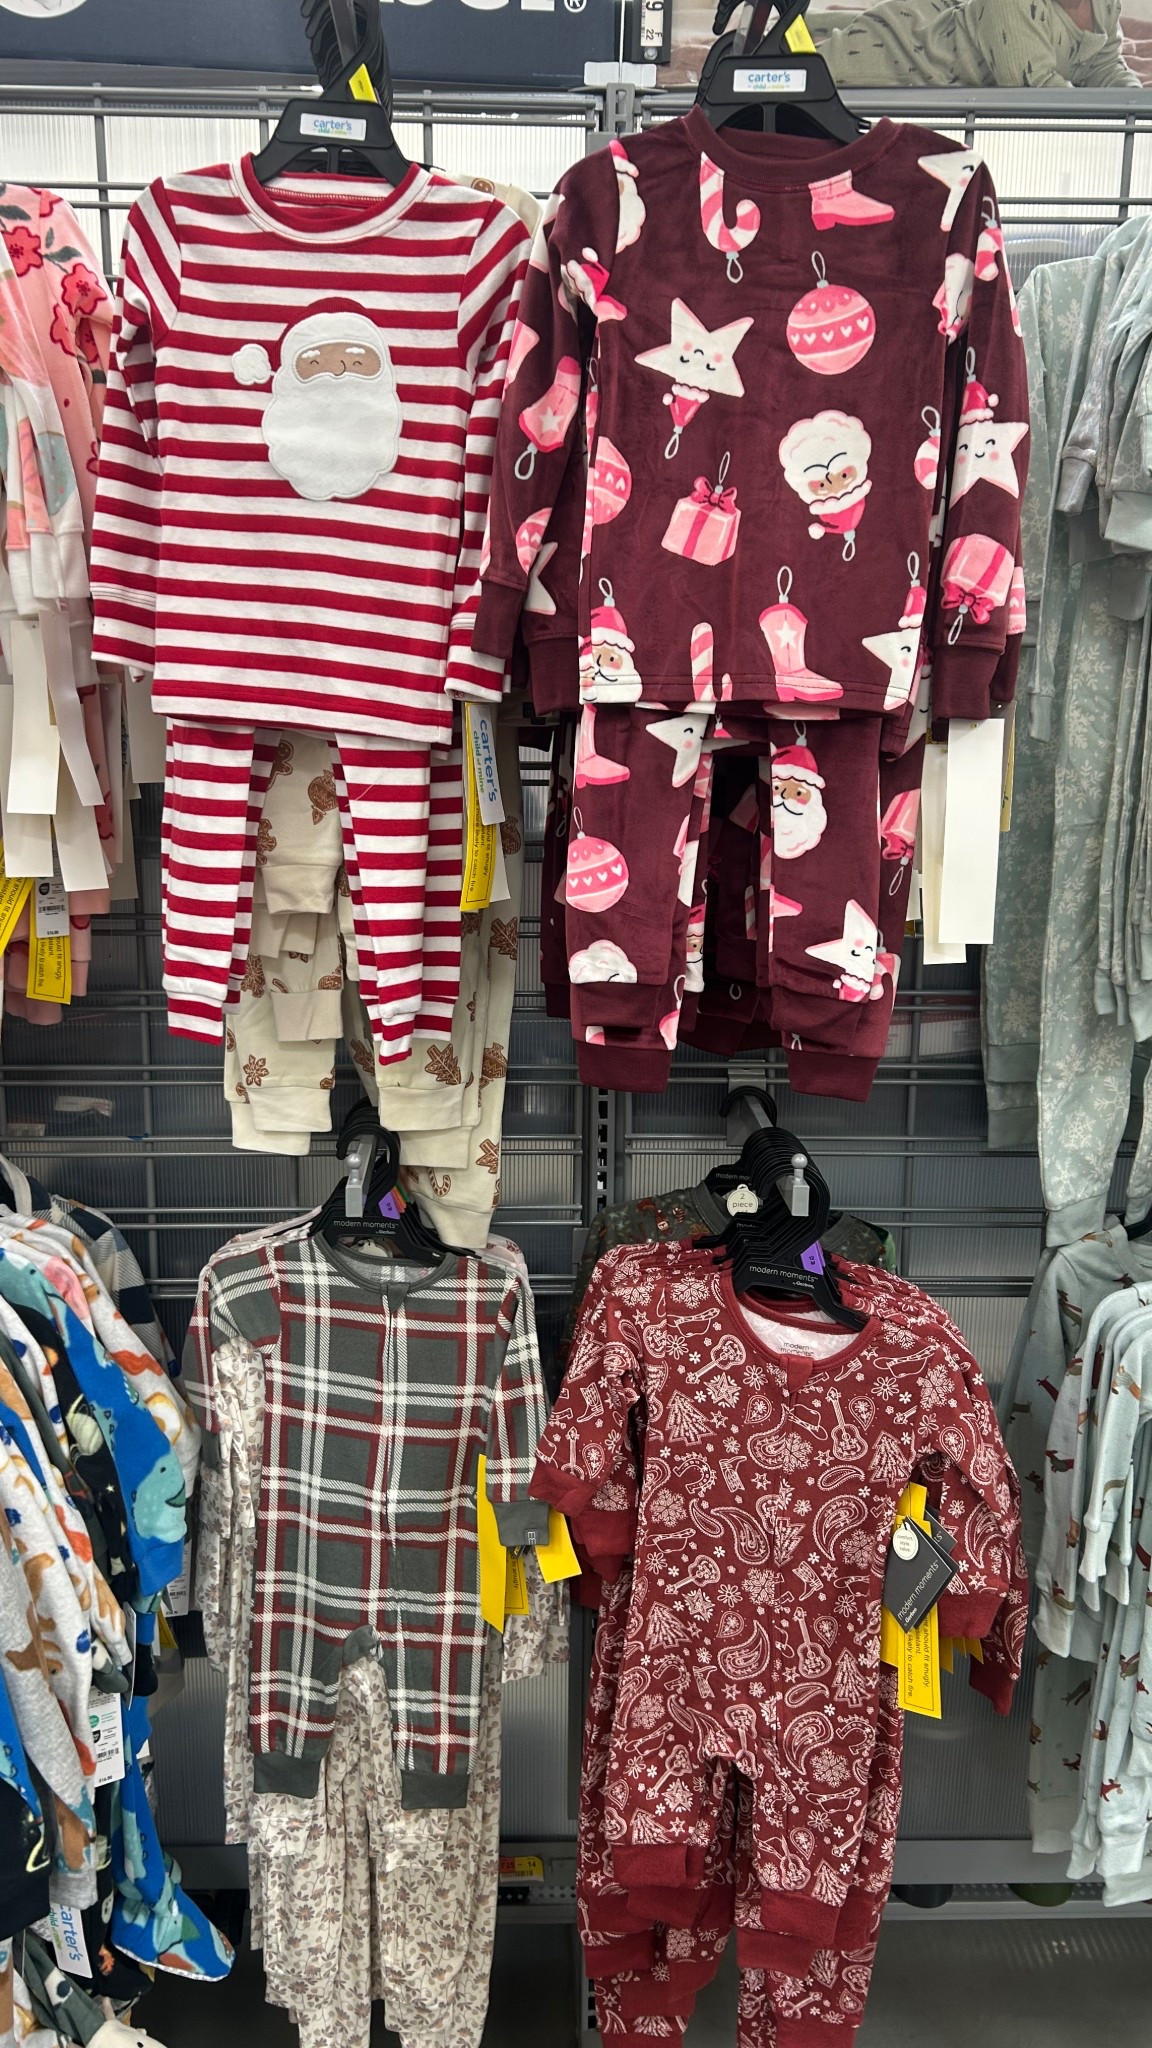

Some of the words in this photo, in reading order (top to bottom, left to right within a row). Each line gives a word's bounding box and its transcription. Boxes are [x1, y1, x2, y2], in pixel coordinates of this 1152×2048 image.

[646, 29, 654, 40] 22
[748, 71, 791, 83] carter's
[313, 119, 353, 132] carter's
[473, 730, 481, 757] child
[480, 719, 498, 802] carter's
[715, 1172, 738, 1180] modern
[732, 1201, 754, 1209] piece
[333, 1220, 362, 1228] modern
[362, 1220, 396, 1229] moments
[749, 1265, 779, 1276] modern
[779, 1270, 815, 1282] moments
[783, 1342, 810, 1350] modern
[897, 1593, 917, 1621] modern
[914, 1562, 940, 1597] moments
[906, 1634, 914, 1654] likely
[907, 1654, 913, 1662] to
